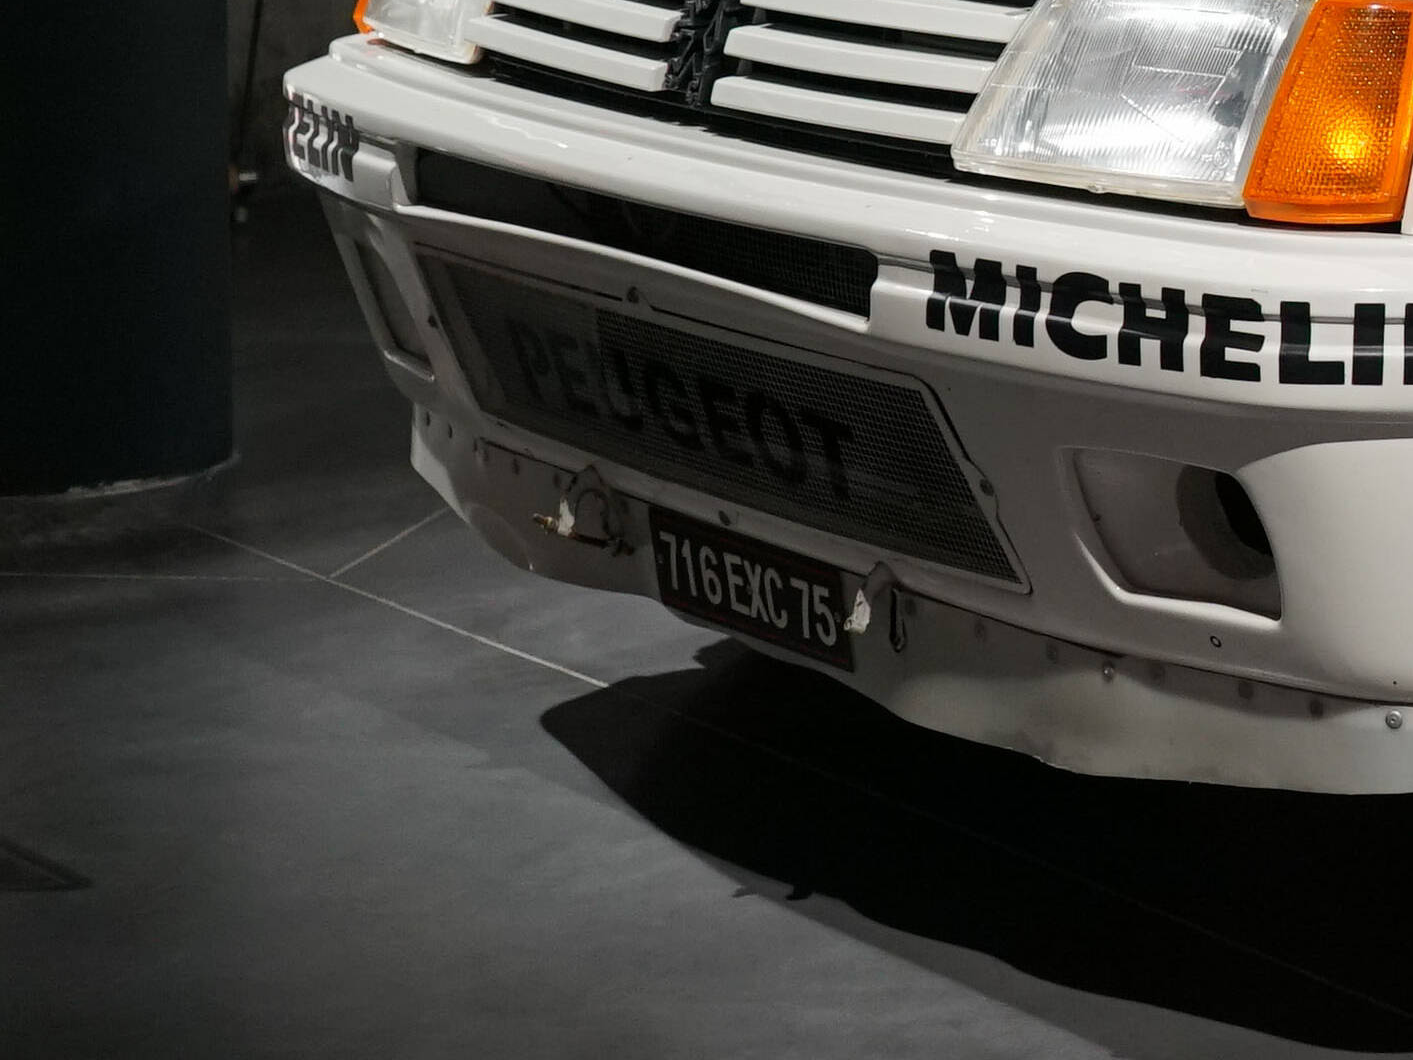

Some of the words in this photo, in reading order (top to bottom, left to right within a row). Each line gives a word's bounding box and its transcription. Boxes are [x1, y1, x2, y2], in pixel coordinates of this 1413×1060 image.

[503, 318, 853, 500] PEUGEOT
[659, 531, 723, 605] 716
[723, 552, 788, 629] EXC
[790, 577, 837, 646] 75
